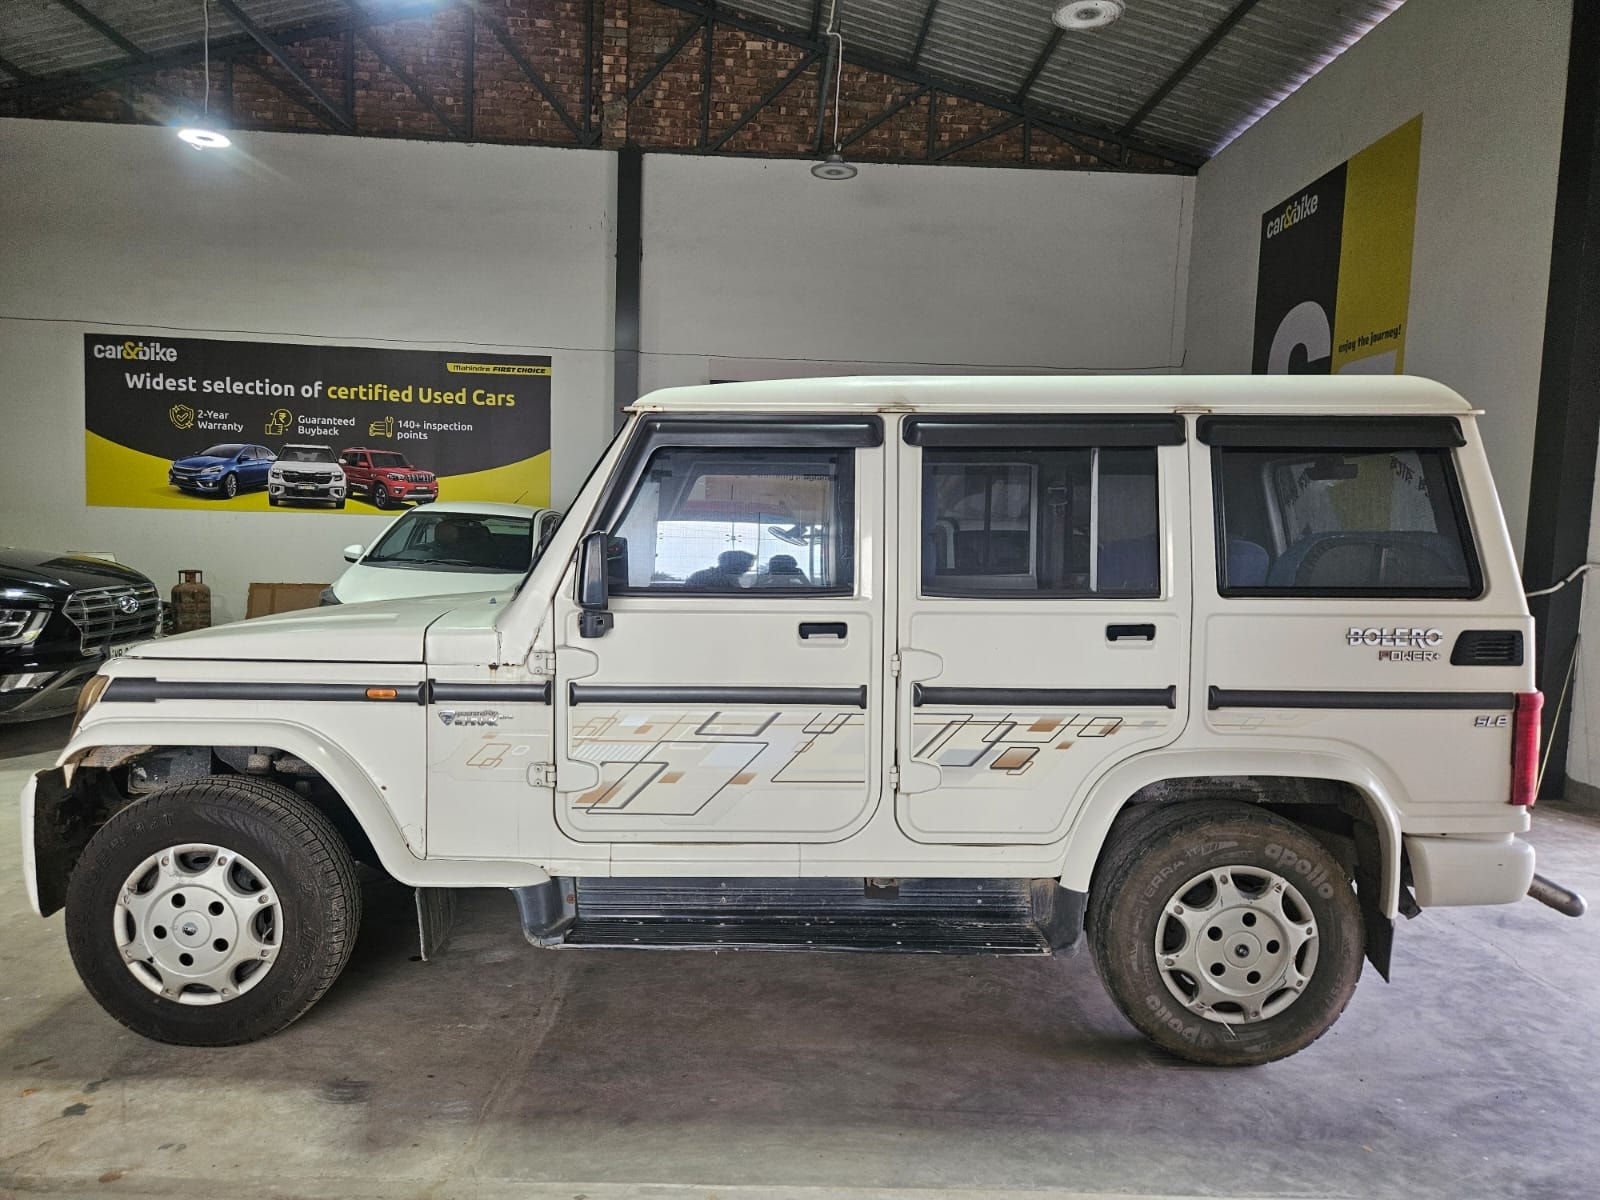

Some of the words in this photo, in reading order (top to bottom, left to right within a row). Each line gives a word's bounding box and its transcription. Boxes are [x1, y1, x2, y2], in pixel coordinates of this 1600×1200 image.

[1266, 193, 1318, 239] car&bike
[1338, 340, 1356, 353] enjoy
[1358, 335, 1369, 347] the
[1370, 324, 1401, 346] journey!
[93, 341, 178, 362] car&bike
[125, 373, 197, 392] Widest
[202, 377, 295, 397] selection
[301, 381, 323, 398] of
[327, 383, 412, 403] certified
[418, 387, 467, 405] Used
[472, 389, 515, 407] Cars
[197, 409, 229, 420] 2-Year
[298, 415, 356, 426] Guaranteed
[198, 421, 244, 433] Warranty
[298, 426, 339, 438] Buyback
[398, 420, 421, 430] 140+
[423, 421, 473, 434] inspection
[397, 431, 428, 441] points
[1347, 627, 1443, 648] BOLERO
[1264, 843, 1334, 899] apollo
